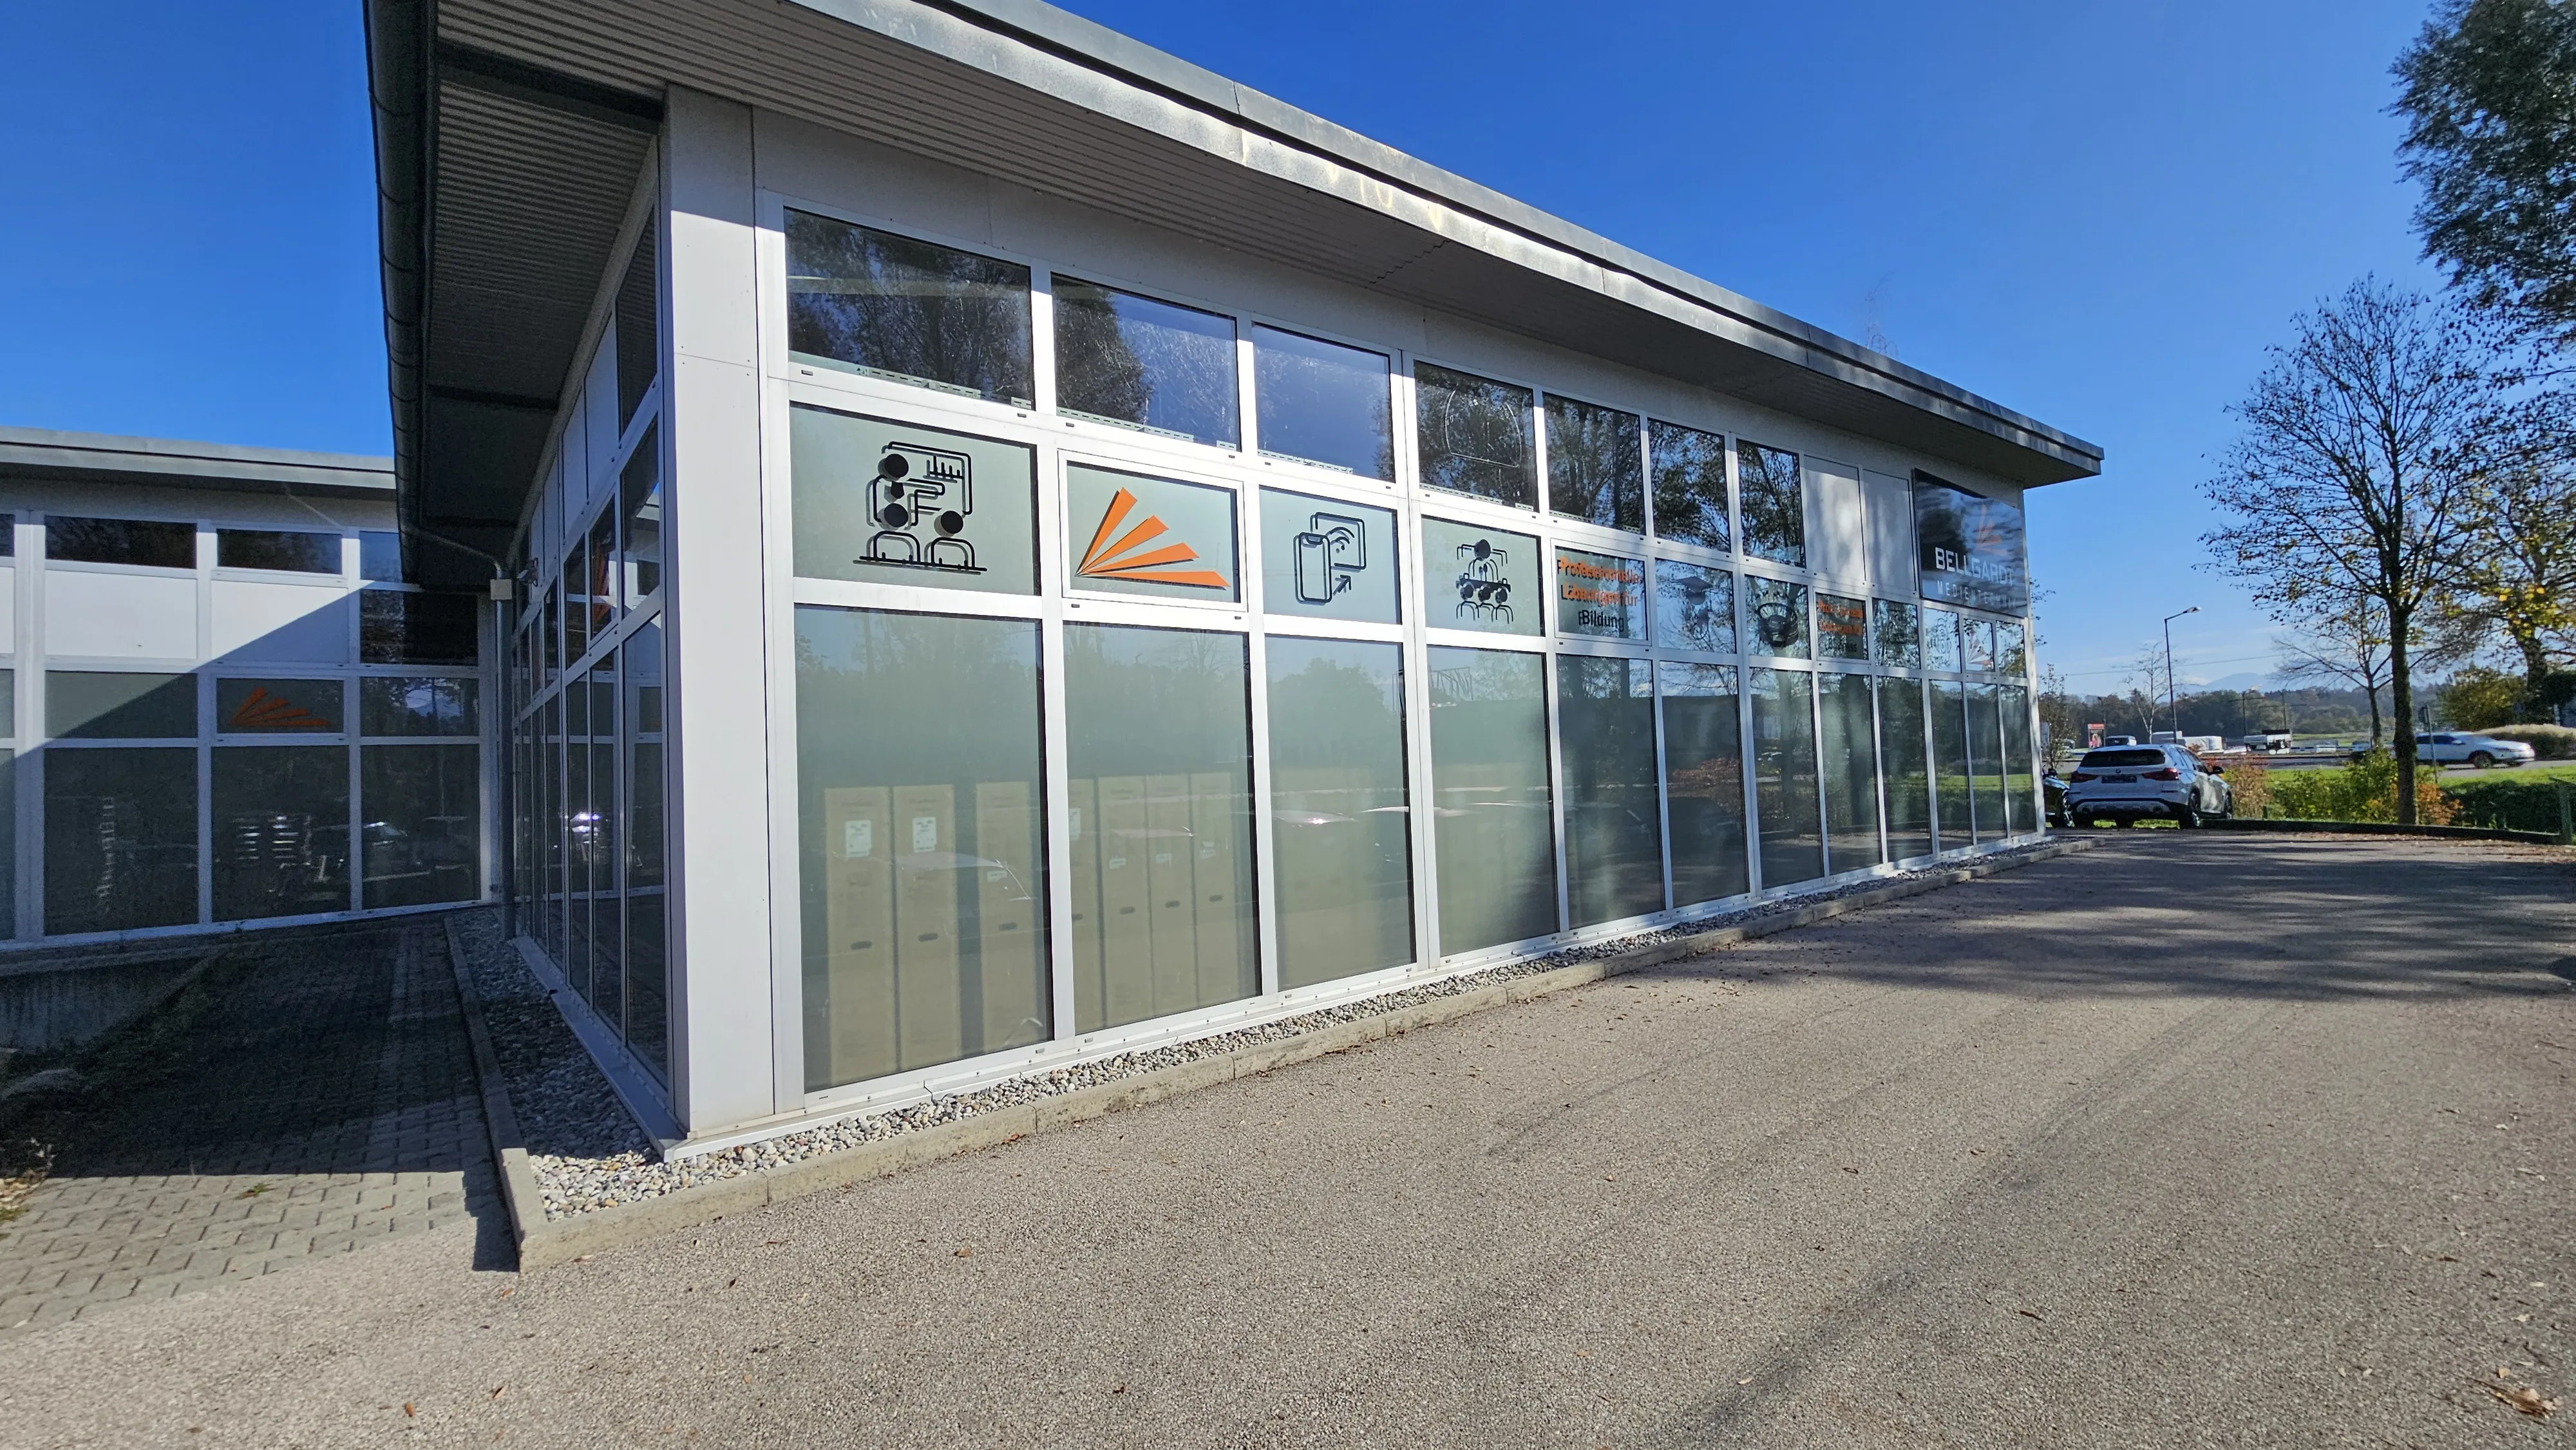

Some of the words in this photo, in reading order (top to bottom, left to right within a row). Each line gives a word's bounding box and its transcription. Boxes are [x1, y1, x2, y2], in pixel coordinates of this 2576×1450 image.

[1557, 556, 1640, 583] Professionelle
[1935, 547, 2014, 587] BELLGARDT
[1579, 609, 1624, 632] Bildung
